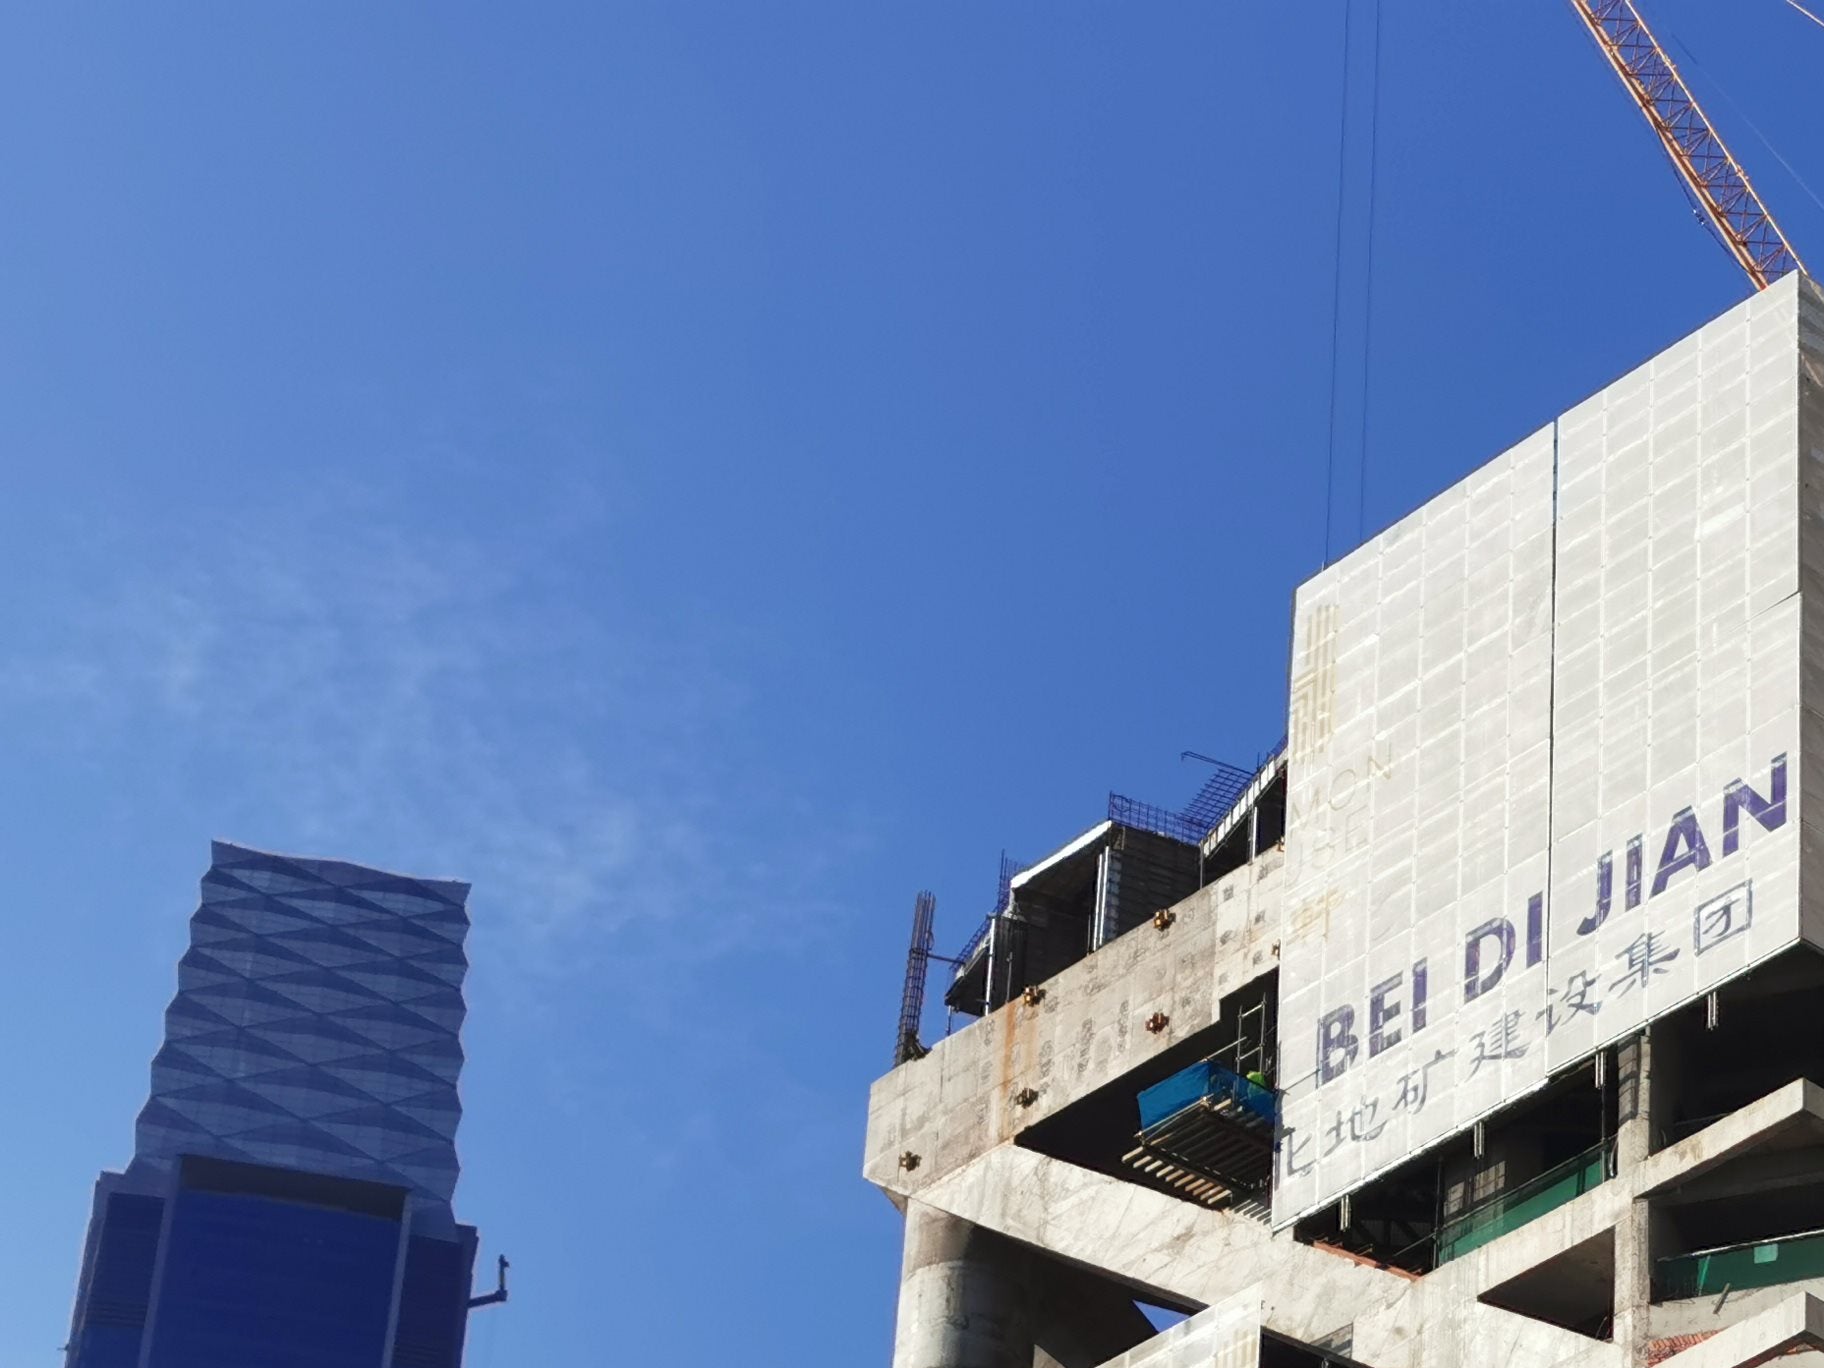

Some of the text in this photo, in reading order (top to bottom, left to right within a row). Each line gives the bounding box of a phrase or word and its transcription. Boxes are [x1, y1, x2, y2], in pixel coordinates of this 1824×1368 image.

[1316, 751, 1788, 1088] BEI DI JIAN
